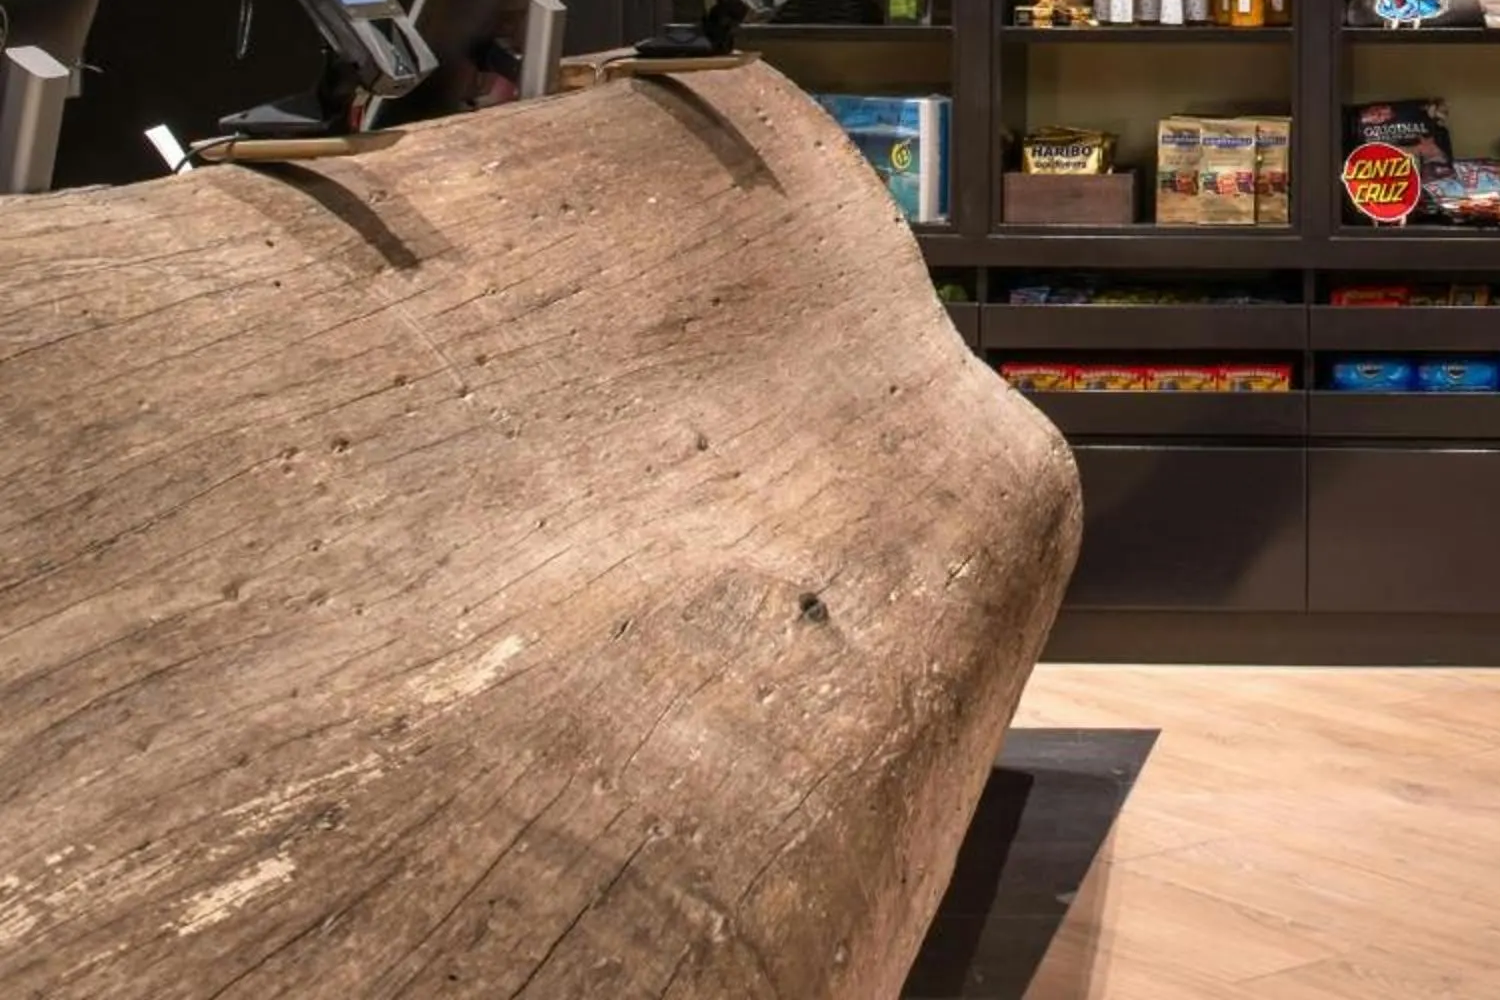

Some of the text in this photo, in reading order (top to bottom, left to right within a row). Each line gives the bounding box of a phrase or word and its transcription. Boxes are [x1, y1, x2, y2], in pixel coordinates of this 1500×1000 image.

[1032, 145, 1092, 158] HARIBO
[1345, 157, 1412, 180] SANTA
[1355, 181, 1409, 203] CRUZ
